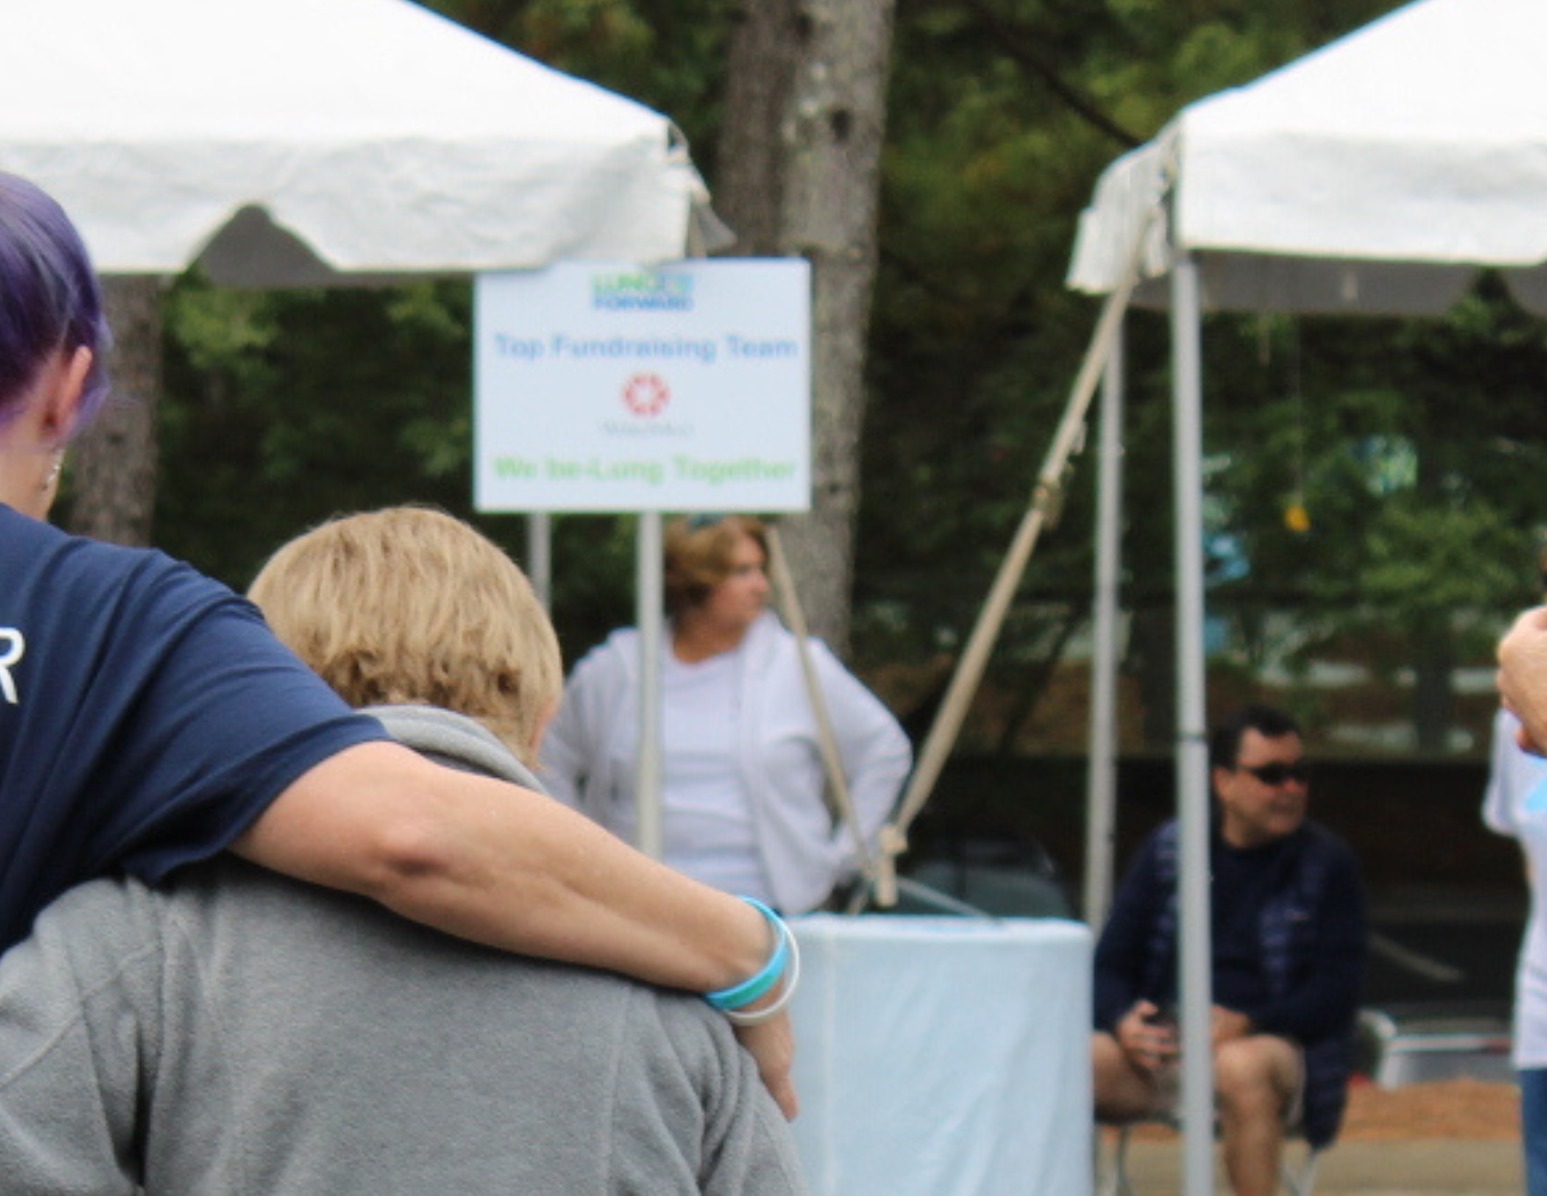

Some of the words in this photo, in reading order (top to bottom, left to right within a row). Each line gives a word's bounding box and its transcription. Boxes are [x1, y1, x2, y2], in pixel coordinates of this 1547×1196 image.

[494, 334, 545, 359] Top
[553, 333, 717, 362] Fundraising
[725, 334, 798, 357] Team
[494, 457, 538, 480] We
[673, 455, 796, 486] Together
